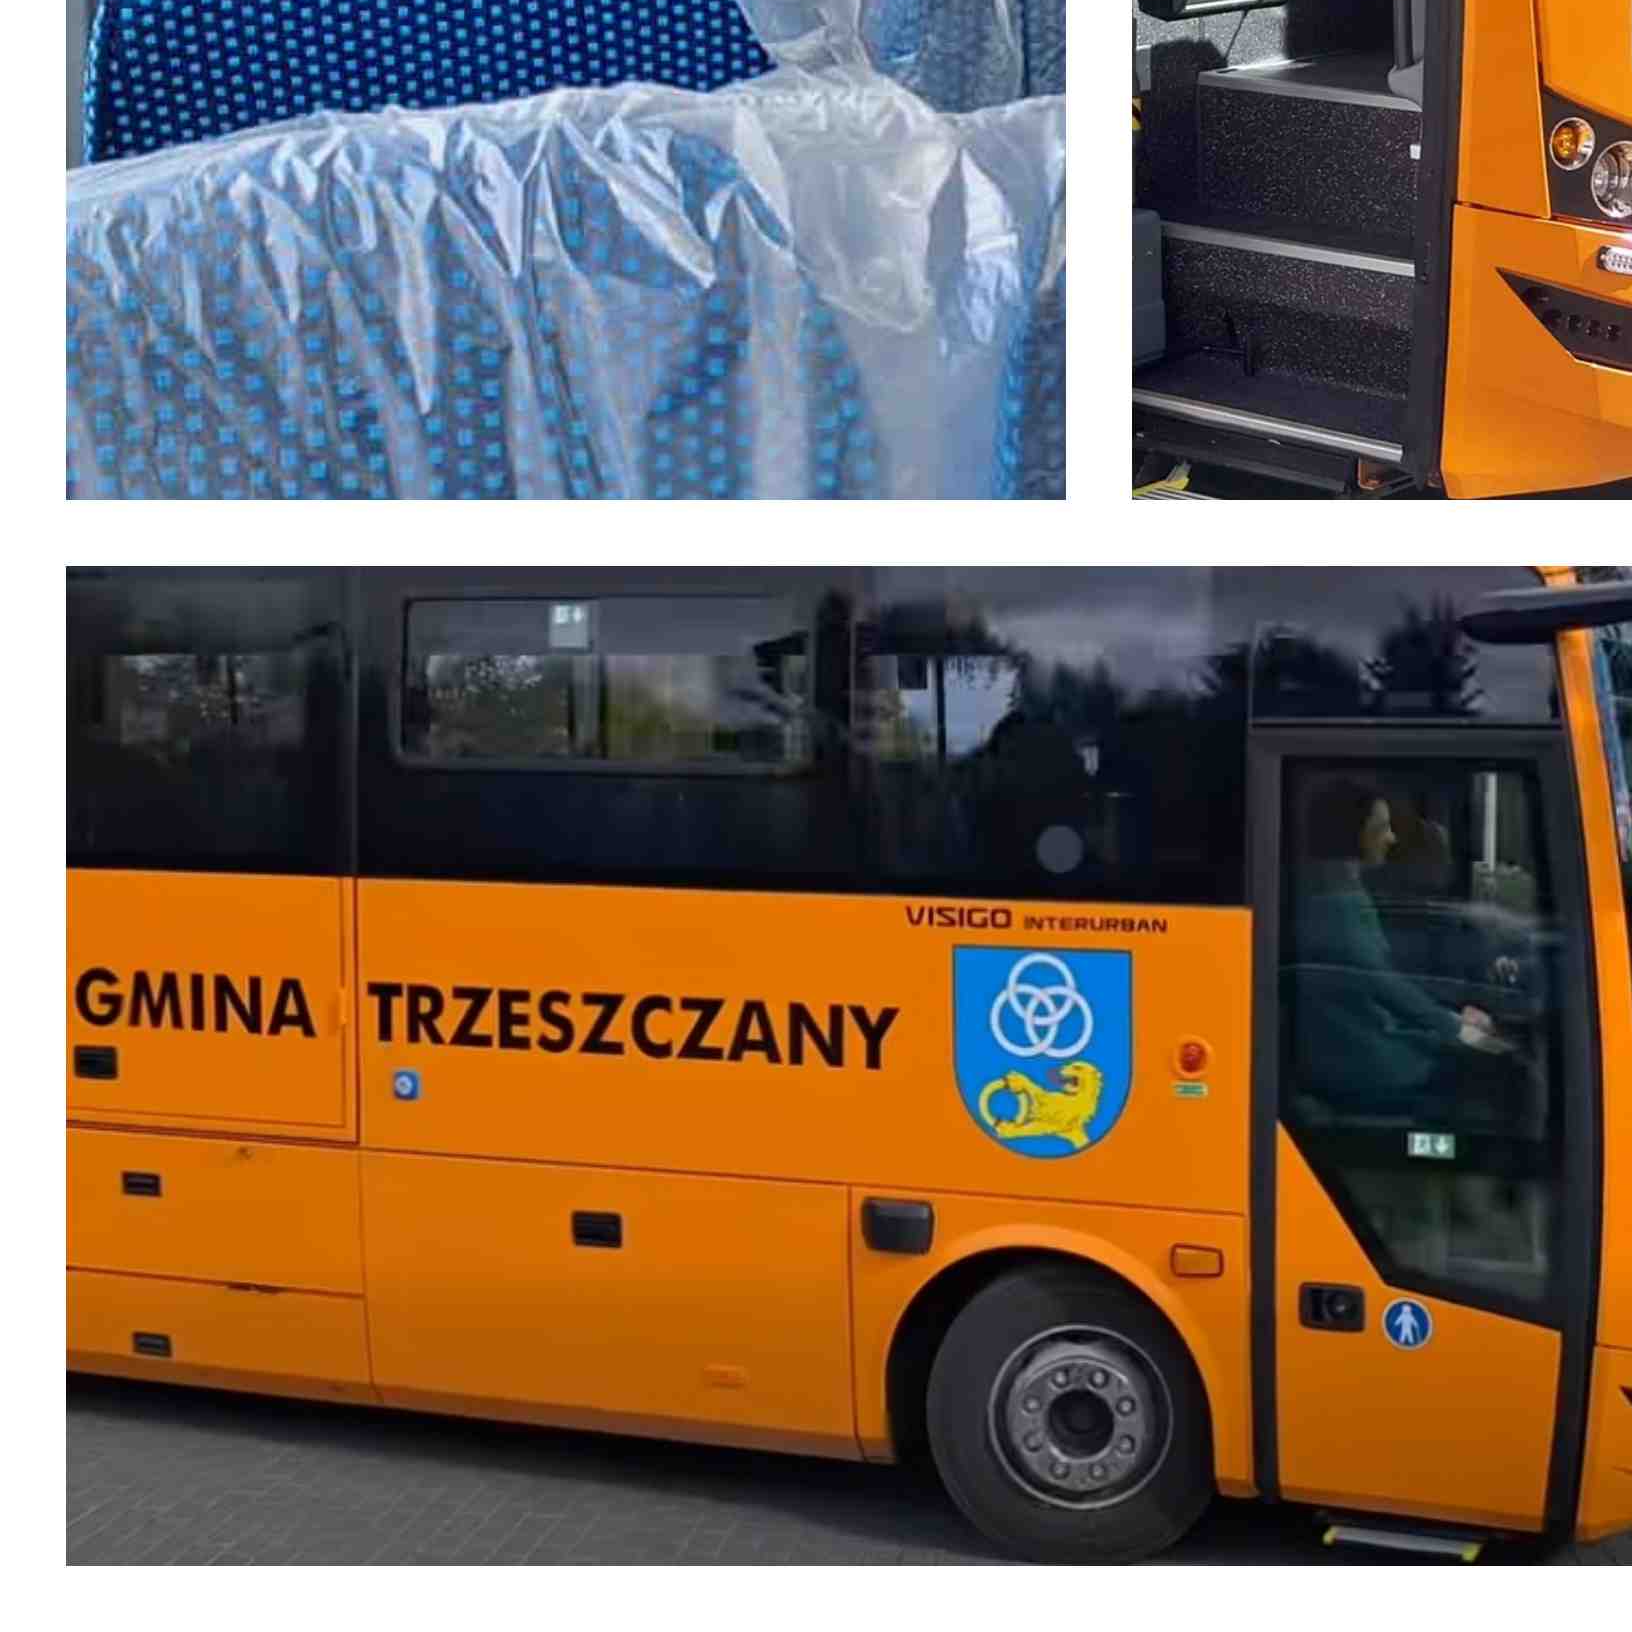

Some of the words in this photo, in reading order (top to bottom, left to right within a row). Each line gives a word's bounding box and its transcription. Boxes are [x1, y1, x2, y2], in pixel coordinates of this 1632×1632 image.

[905, 905, 1013, 929] VISIGO
[1023, 915, 1168, 933] INTERURBAN
[74, 967, 318, 1038] GMINA
[367, 981, 901, 1070] TRZESZCZANY
